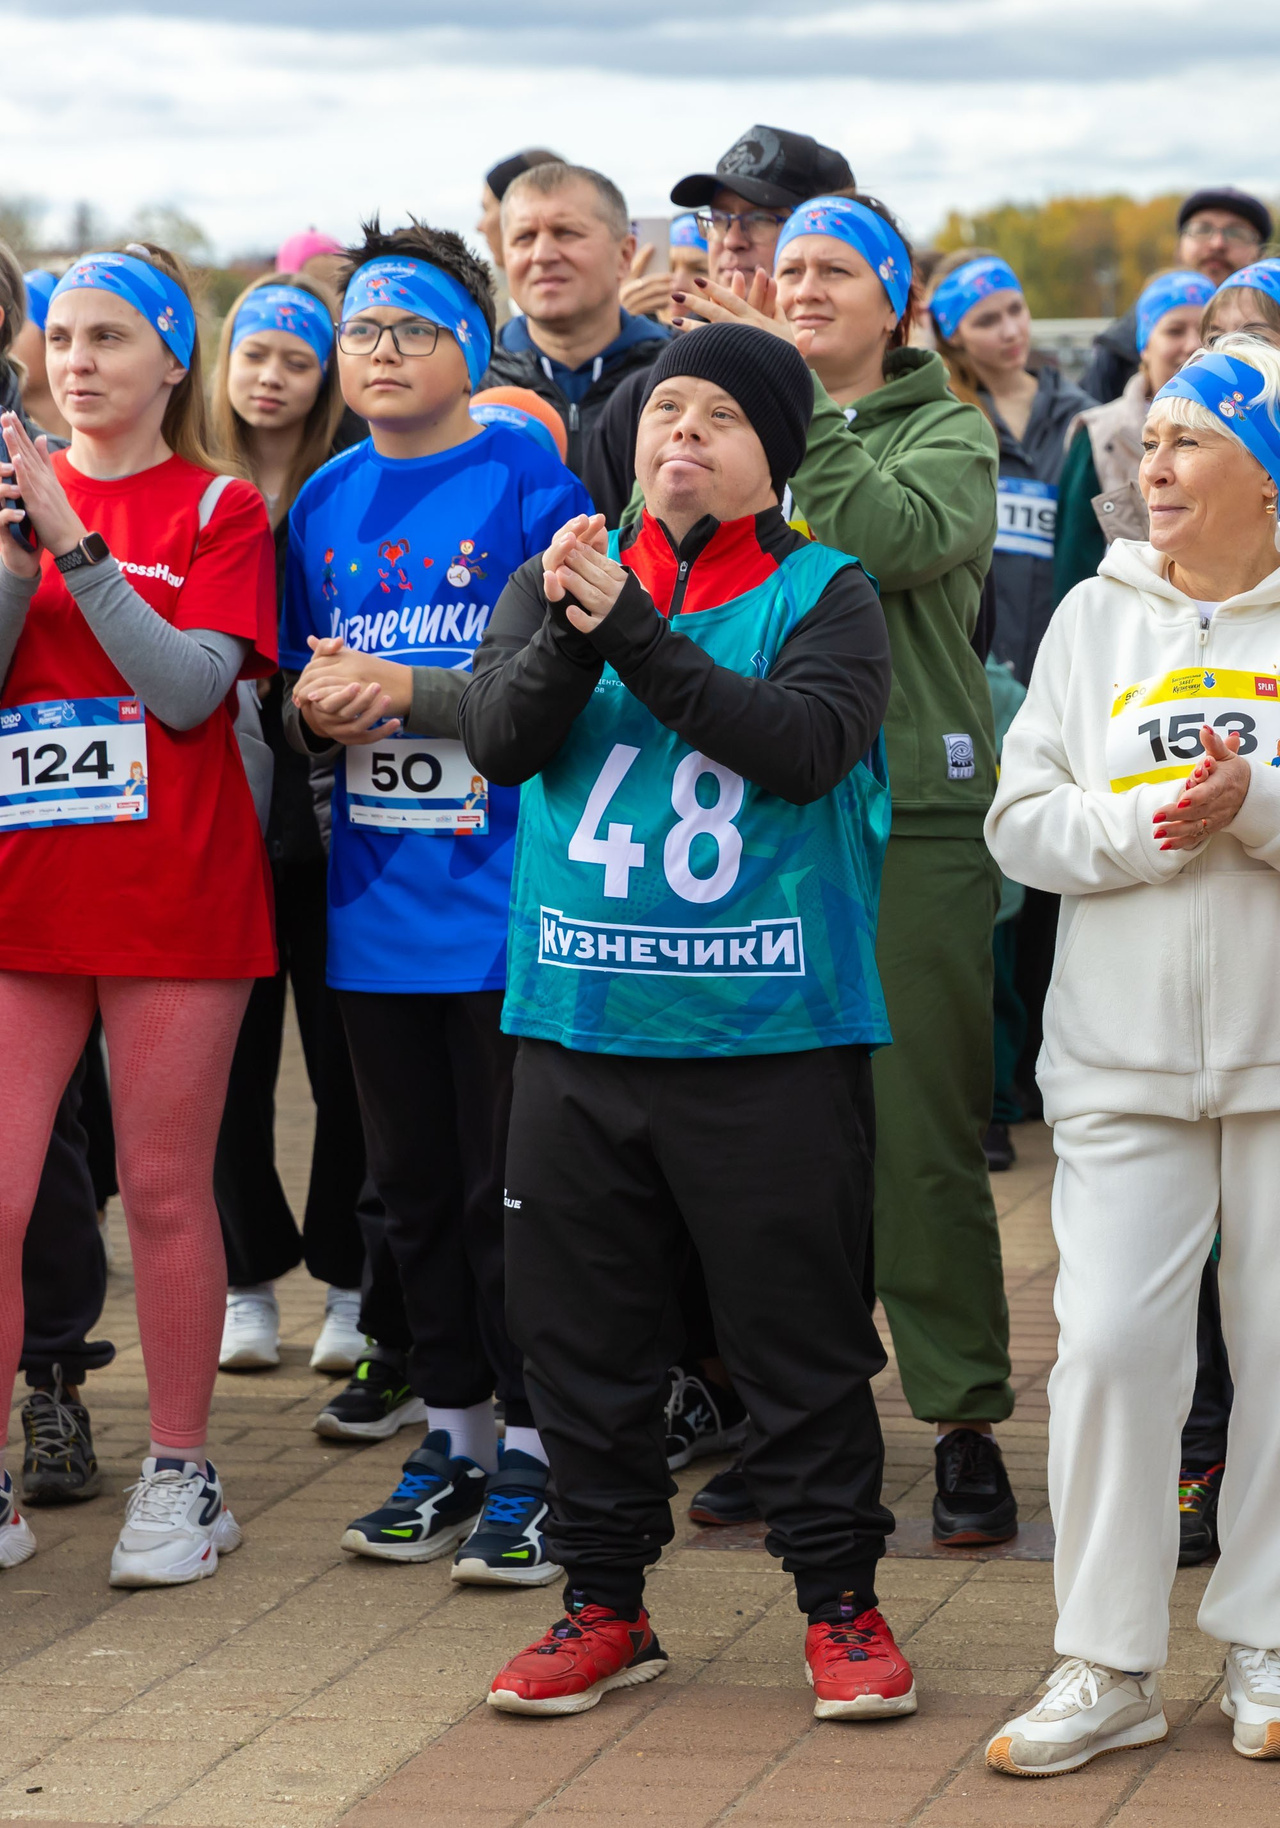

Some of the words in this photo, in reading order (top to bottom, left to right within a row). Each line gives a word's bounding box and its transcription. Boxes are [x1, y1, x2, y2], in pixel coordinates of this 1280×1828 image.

[1004, 503, 1057, 533] 119
[115, 558, 185, 588] rossHau
[1257, 682, 1275, 692] SPLAT
[1138, 711, 1258, 763] 153
[12, 740, 115, 787] 124
[371, 751, 443, 793] 50
[568, 743, 745, 904] 48
[543, 917, 796, 966] КУЗНЕЧИКИ
